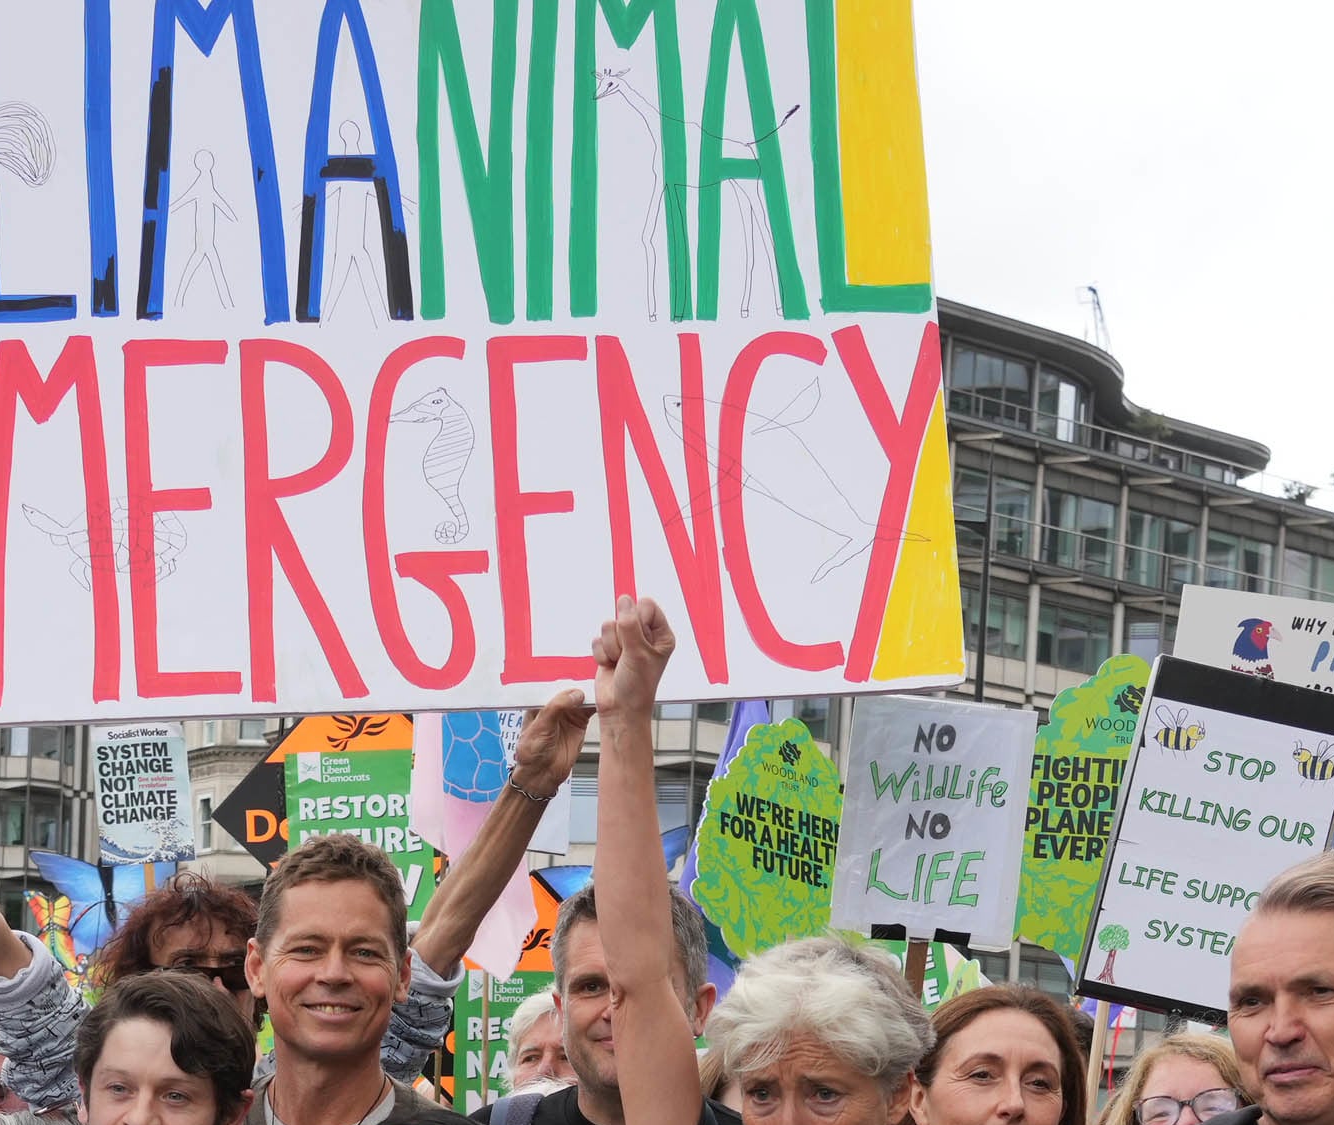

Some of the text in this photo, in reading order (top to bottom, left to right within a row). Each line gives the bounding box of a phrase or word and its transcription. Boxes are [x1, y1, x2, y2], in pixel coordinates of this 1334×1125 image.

[1291, 616, 1327, 636] WHY
[107, 727, 168, 741] Socialist Worker
[1085, 717, 1137, 732] WOOD
[913, 722, 957, 755] NO
[1114, 735, 1133, 745] TRU
[97, 741, 168, 761] SYSTEM
[98, 757, 173, 777] CHANGE
[322, 757, 350, 766] Green
[322, 765, 351, 775] Liberal
[1030, 754, 1129, 785] FIGHTI
[1203, 750, 1276, 782] STOP
[100, 776, 135, 793] NOT
[322, 773, 371, 783] Democrats
[762, 762, 819, 788] WOODLAND
[781, 781, 800, 792] TRUST
[1036, 781, 1119, 811] PEOP
[101, 789, 178, 809] CLIMATE
[102, 805, 177, 826] CHANGE
[905, 810, 952, 841] NO
[1024, 806, 1114, 836] PLANE
[1139, 787, 1315, 846] KILLING OUR
[720, 811, 838, 866] FOR A HEALT
[753, 845, 828, 889] FUTURE.
[865, 848, 986, 907] LIFE
[1118, 862, 1261, 912] LIFE SUPPO
[494, 984, 524, 994] Liberal
[494, 993, 530, 1003] Democ
